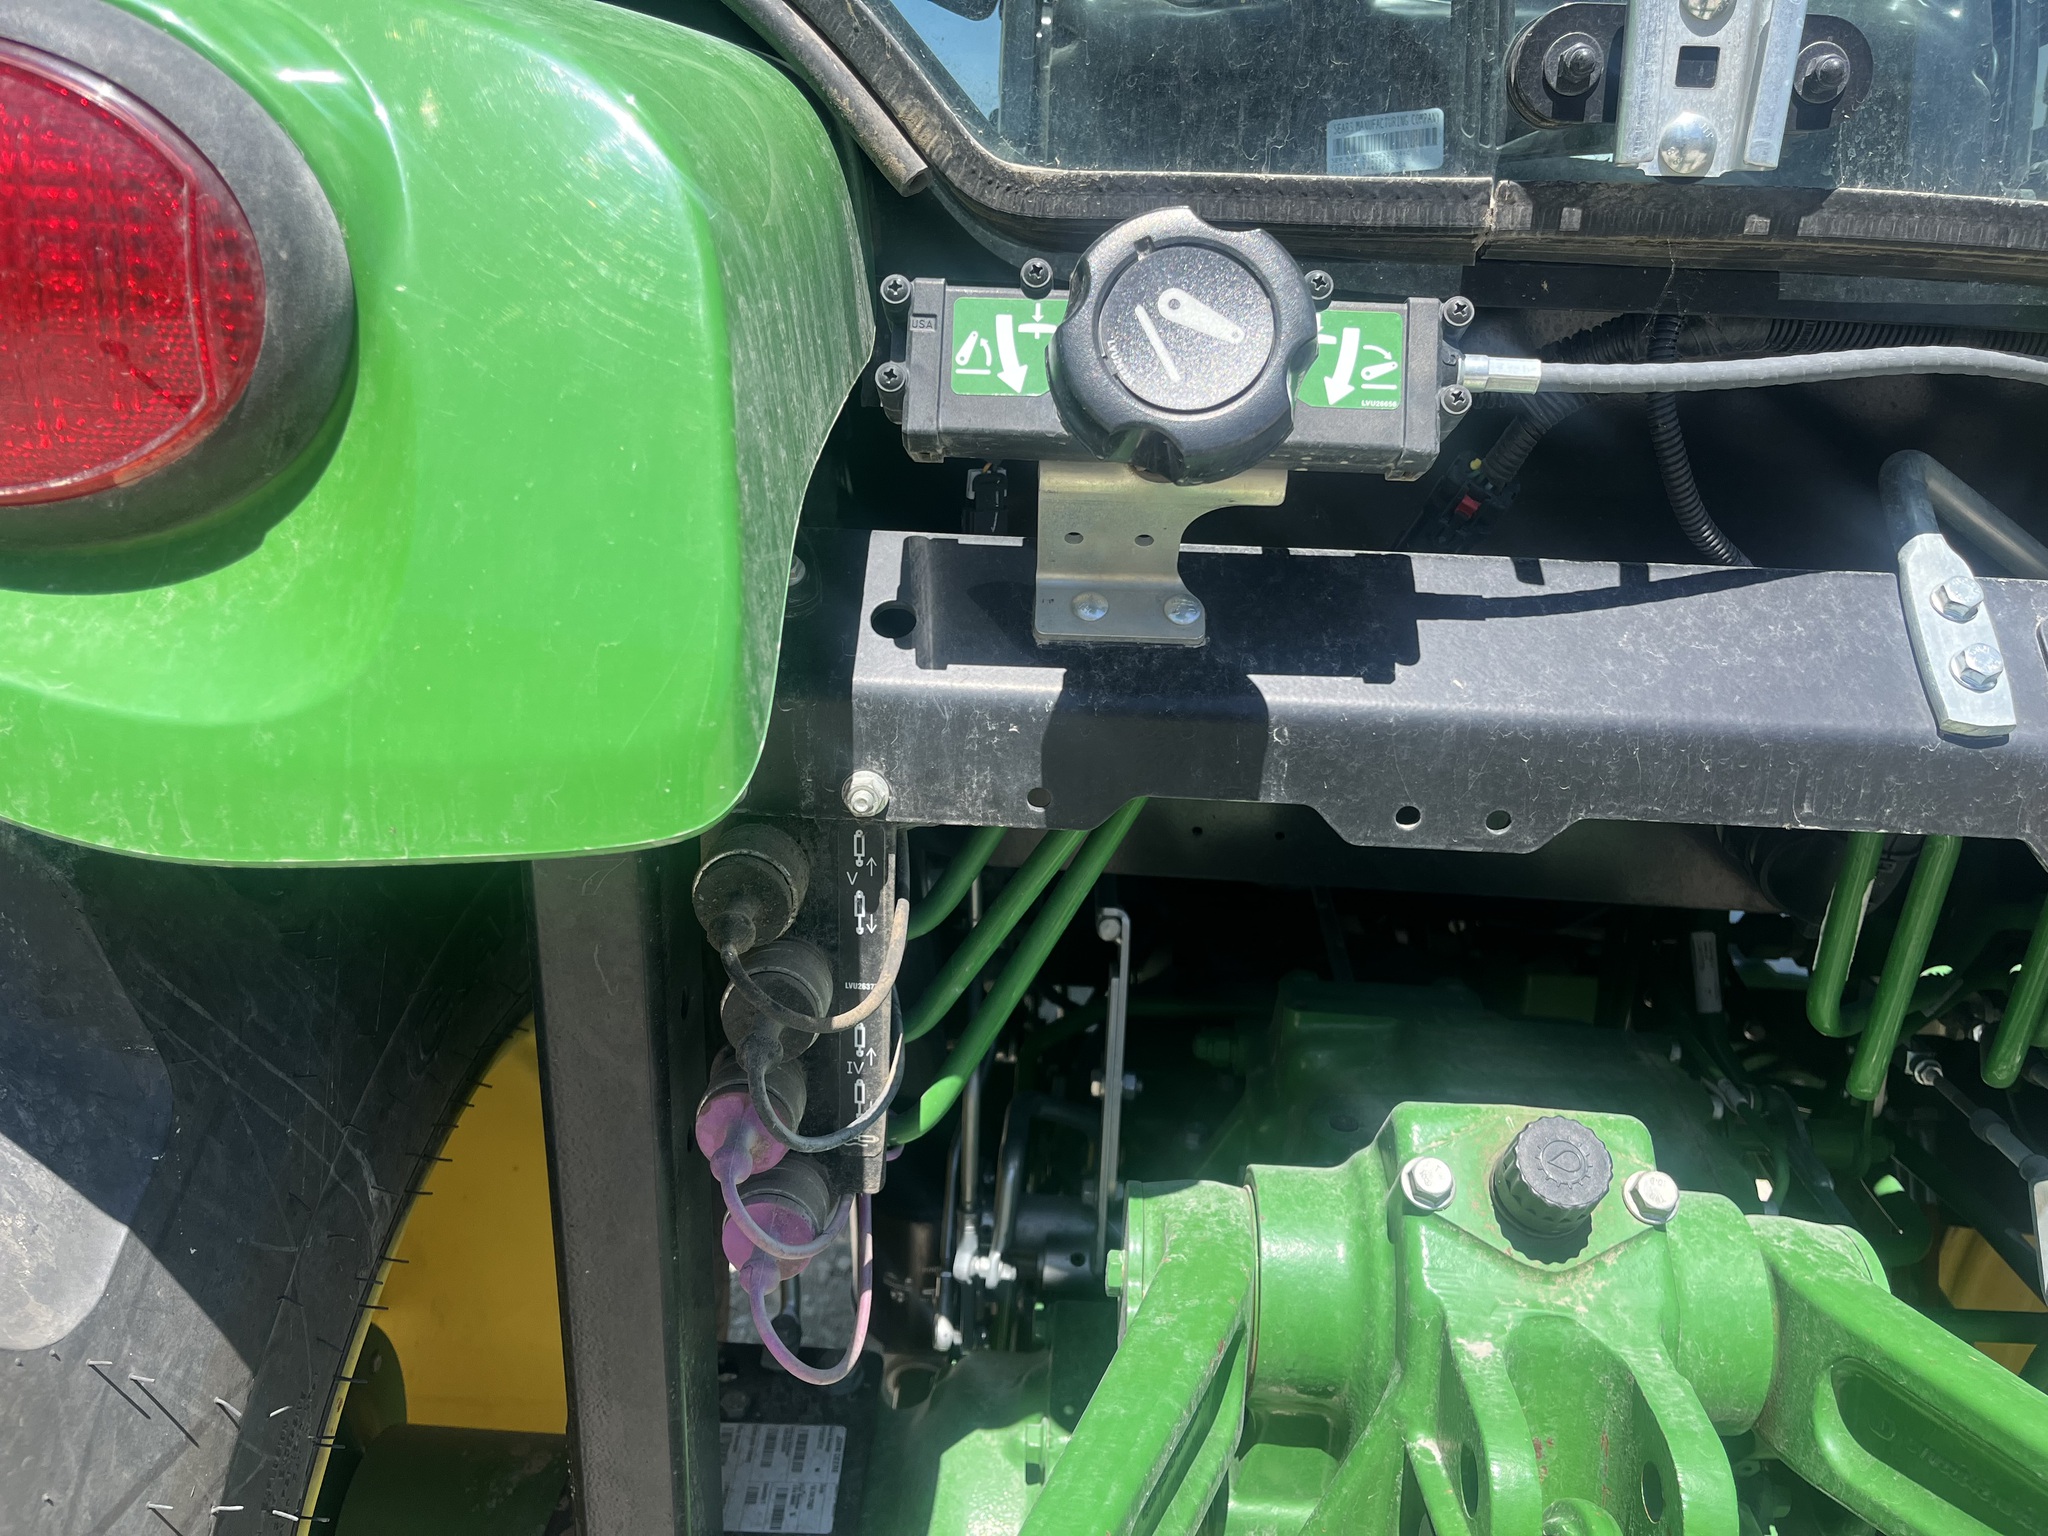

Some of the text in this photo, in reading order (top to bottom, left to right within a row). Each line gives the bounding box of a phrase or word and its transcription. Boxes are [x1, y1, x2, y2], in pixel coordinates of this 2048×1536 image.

[912, 319, 933, 329] USA
[846, 871, 858, 886] V
[844, 981, 877, 991] LVU2637
[846, 1060, 864, 1075] IV
